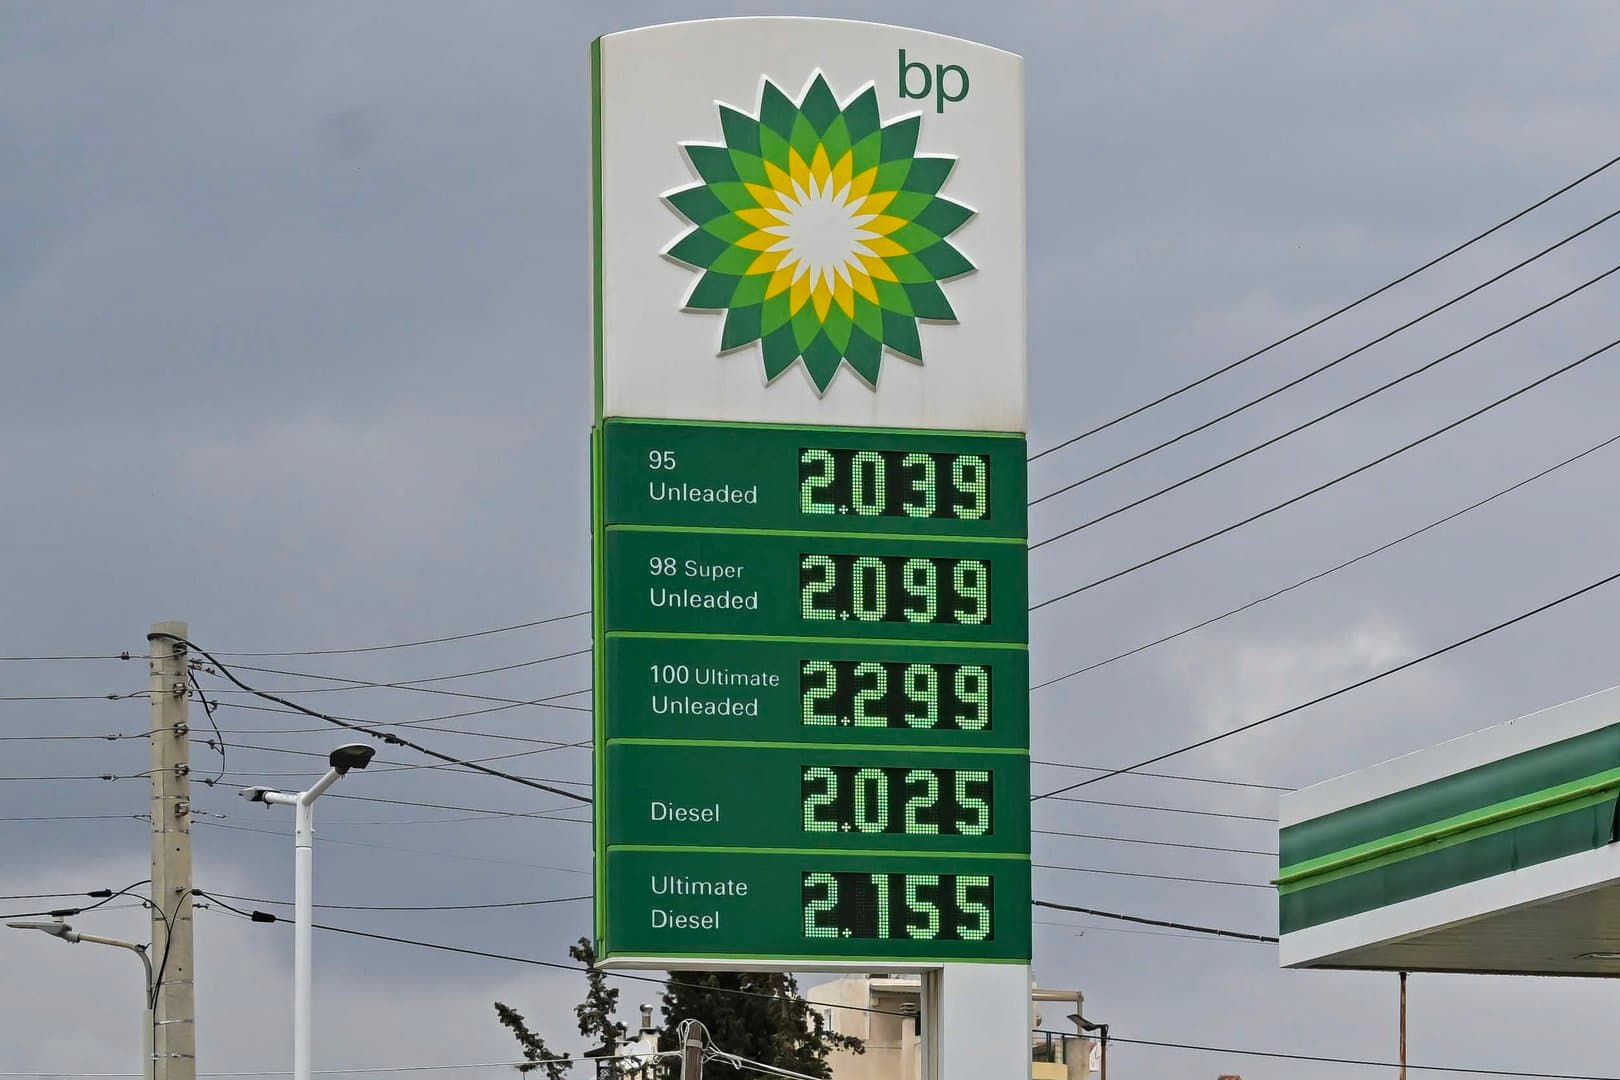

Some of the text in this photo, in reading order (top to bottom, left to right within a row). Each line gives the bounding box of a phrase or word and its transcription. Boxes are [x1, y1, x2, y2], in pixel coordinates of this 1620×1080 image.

[898, 49, 970, 113] bp
[648, 451, 676, 470] 95
[649, 483, 758, 504] Unleaded
[801, 449, 987, 520] 2.039
[649, 557, 744, 579] 98 Super
[650, 589, 758, 610] Unleaded
[802, 554, 988, 625] 2.099
[650, 665, 780, 688] 100 Ultimate
[802, 660, 989, 730] 2.299
[651, 696, 758, 717] Unleaded
[650, 801, 720, 823] Diesel
[803, 767, 990, 836] 2.025
[651, 876, 748, 897] Ultimate
[803, 873, 991, 941] 2.155
[651, 909, 720, 930] Diesel
